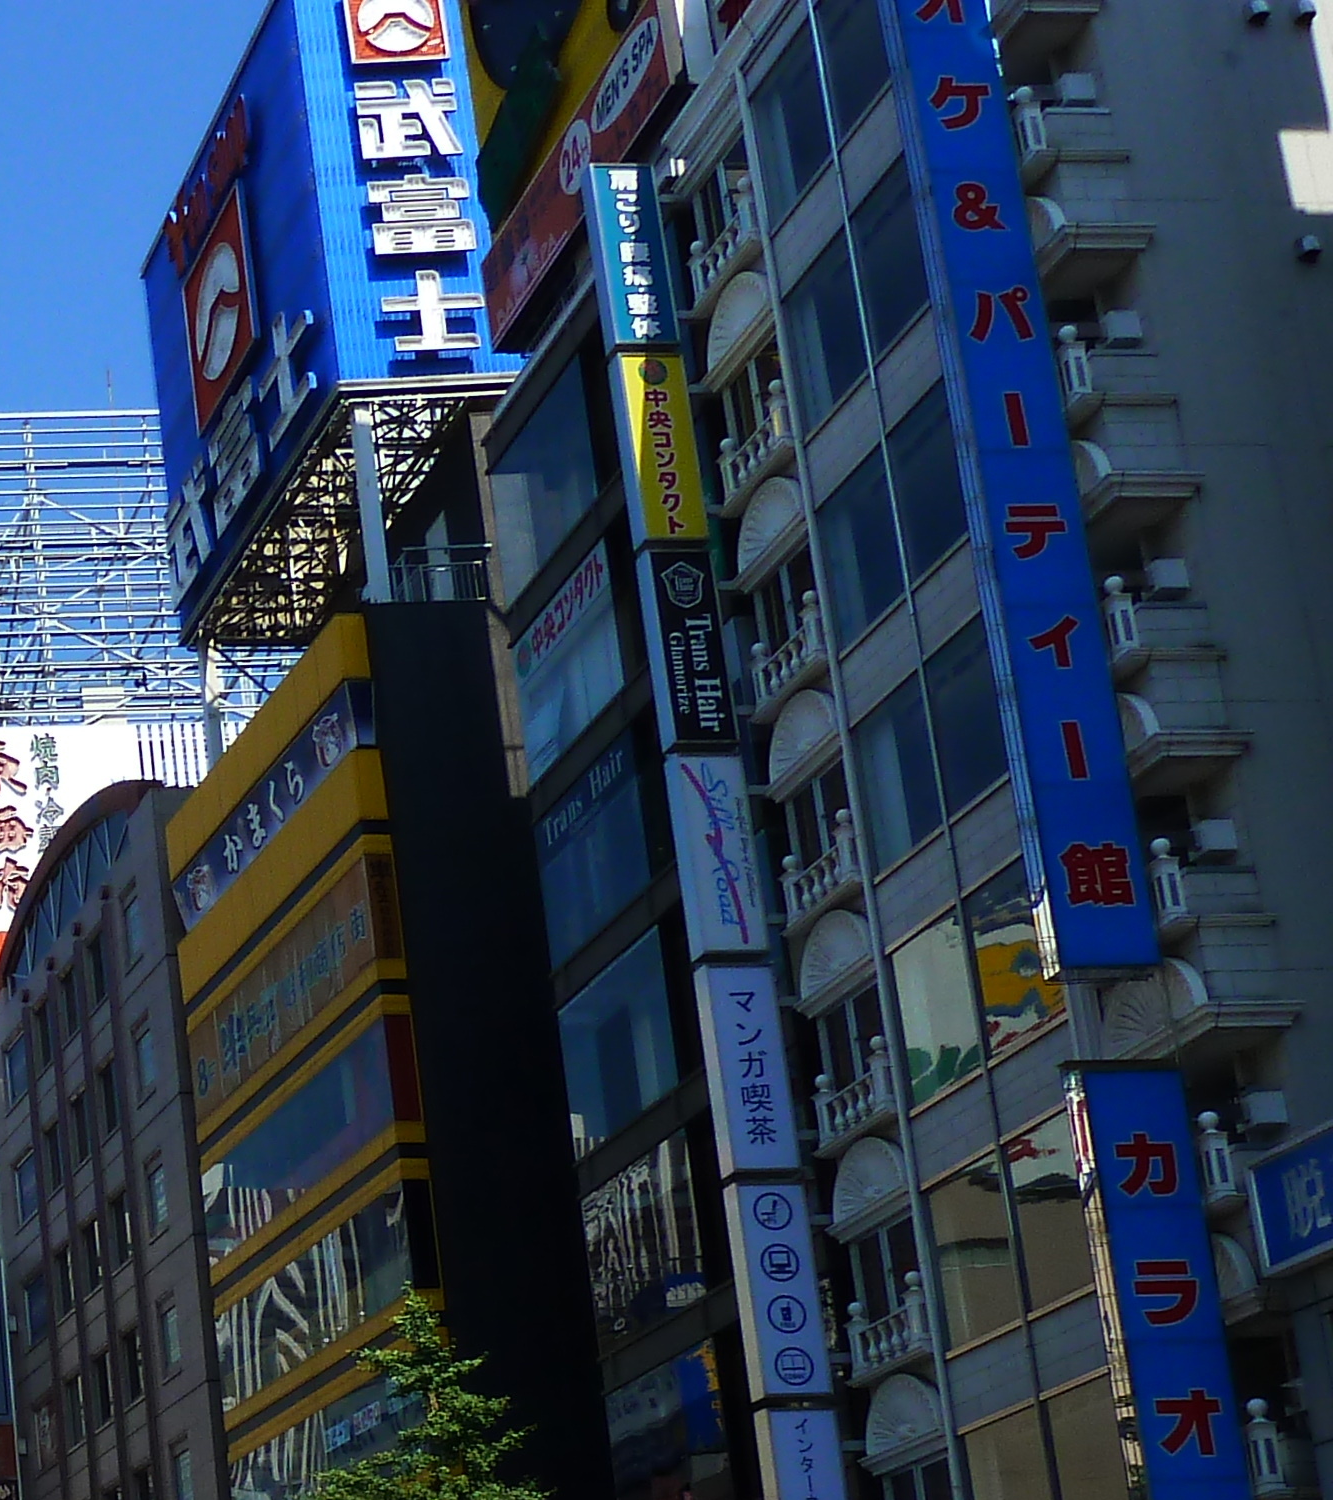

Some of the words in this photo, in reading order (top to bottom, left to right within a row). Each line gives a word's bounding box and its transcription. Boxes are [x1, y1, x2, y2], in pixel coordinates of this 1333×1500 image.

[353, 79, 486, 352] 武富士
[643, 388, 687, 536] 中央コンタクト
[532, 552, 606, 660] 中央コンタクト
[683, 612, 710, 678] Trans
[697, 676, 721, 733] Hair
[222, 758, 305, 872] かまくら
[542, 800, 585, 848] Trans
[588, 748, 625, 801] Hair
[729, 990, 778, 1145] マンガ喫茶
